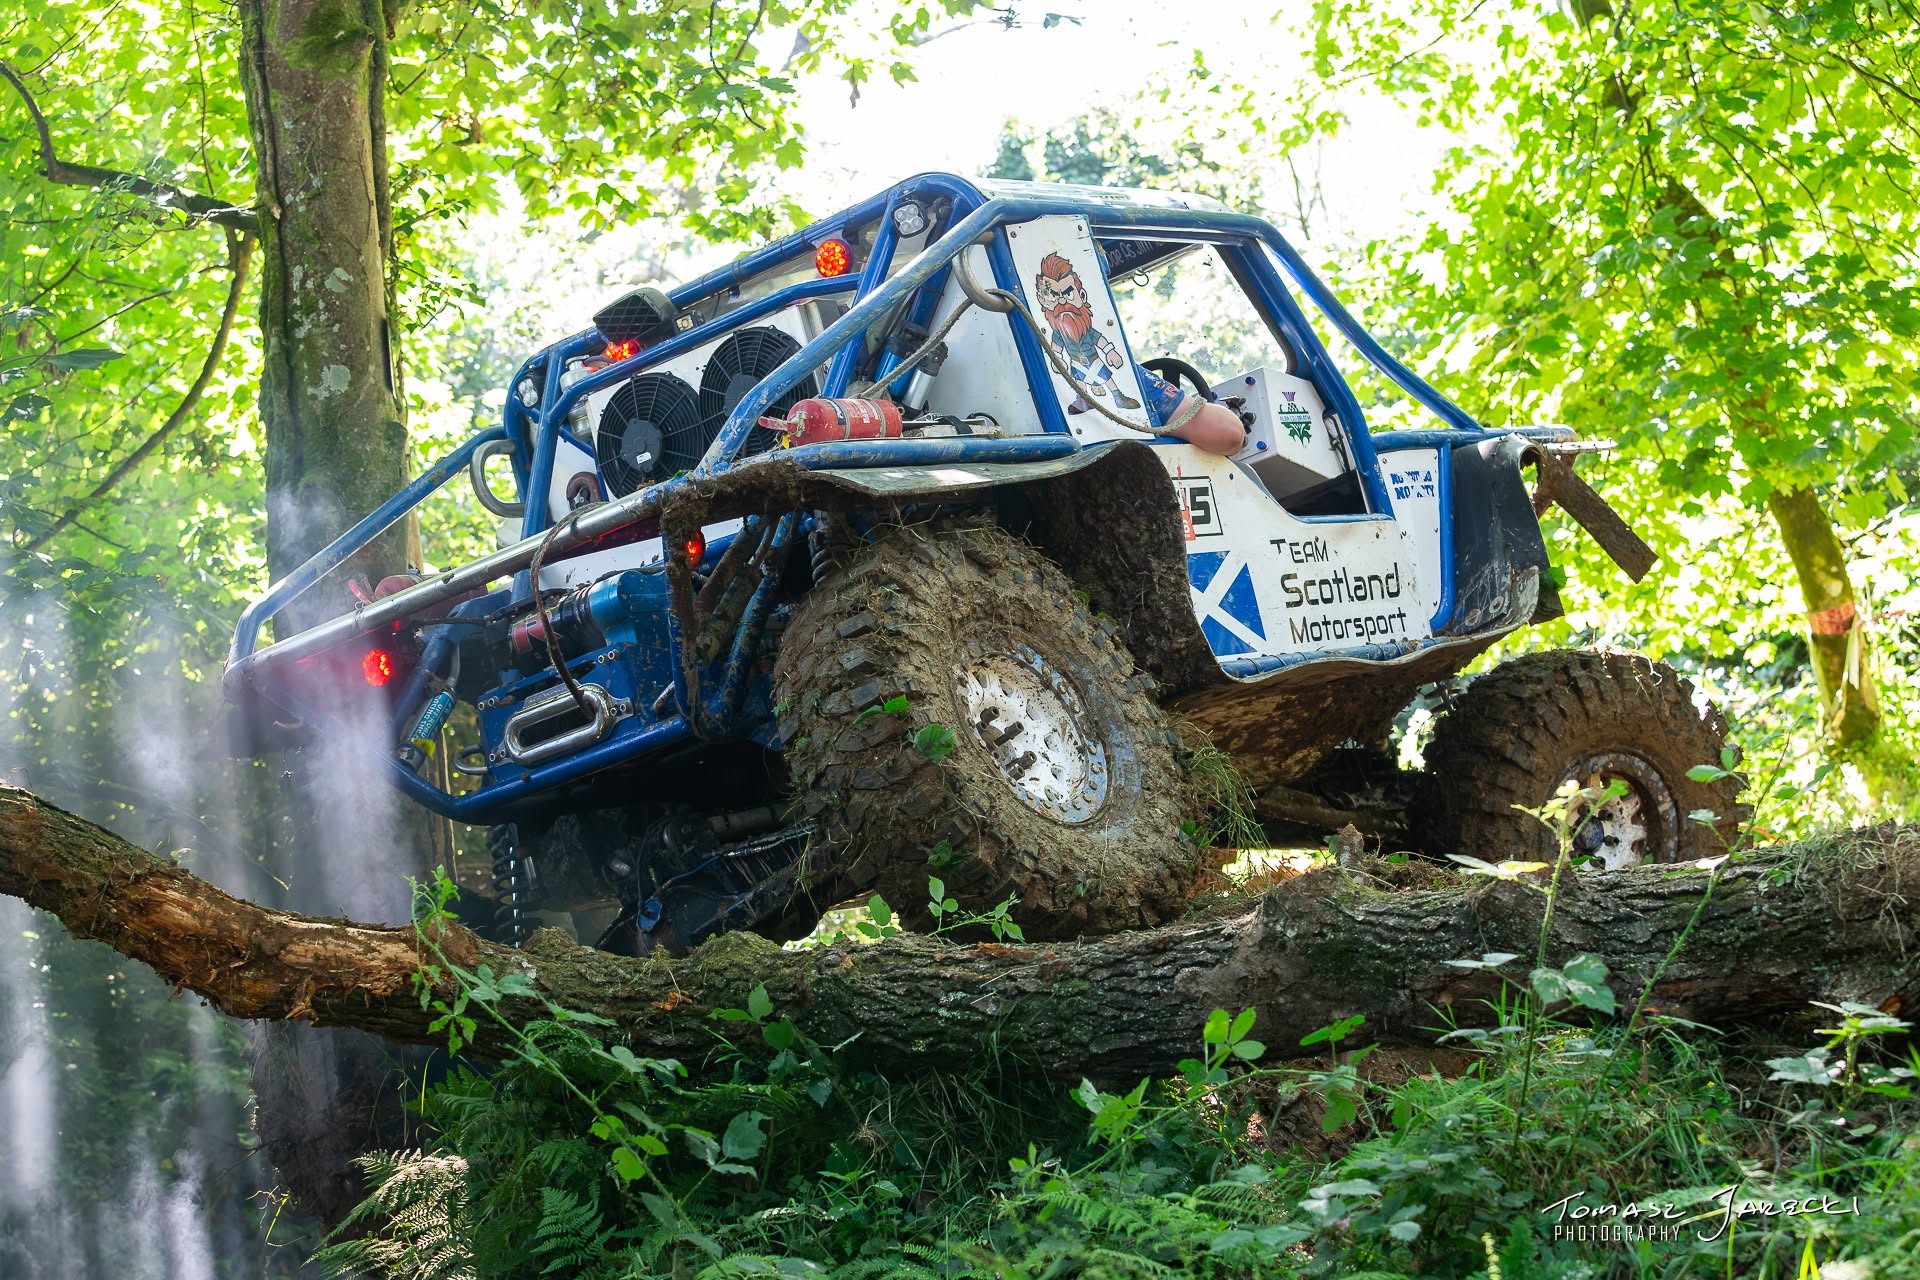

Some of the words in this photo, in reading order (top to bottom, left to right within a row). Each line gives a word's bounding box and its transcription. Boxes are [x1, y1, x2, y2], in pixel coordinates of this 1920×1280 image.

[1395, 486, 1411, 500] NO
[1269, 538, 1330, 563] TEAM
[1280, 562, 1401, 608] Scotland
[1289, 607, 1407, 644] Motorsport
